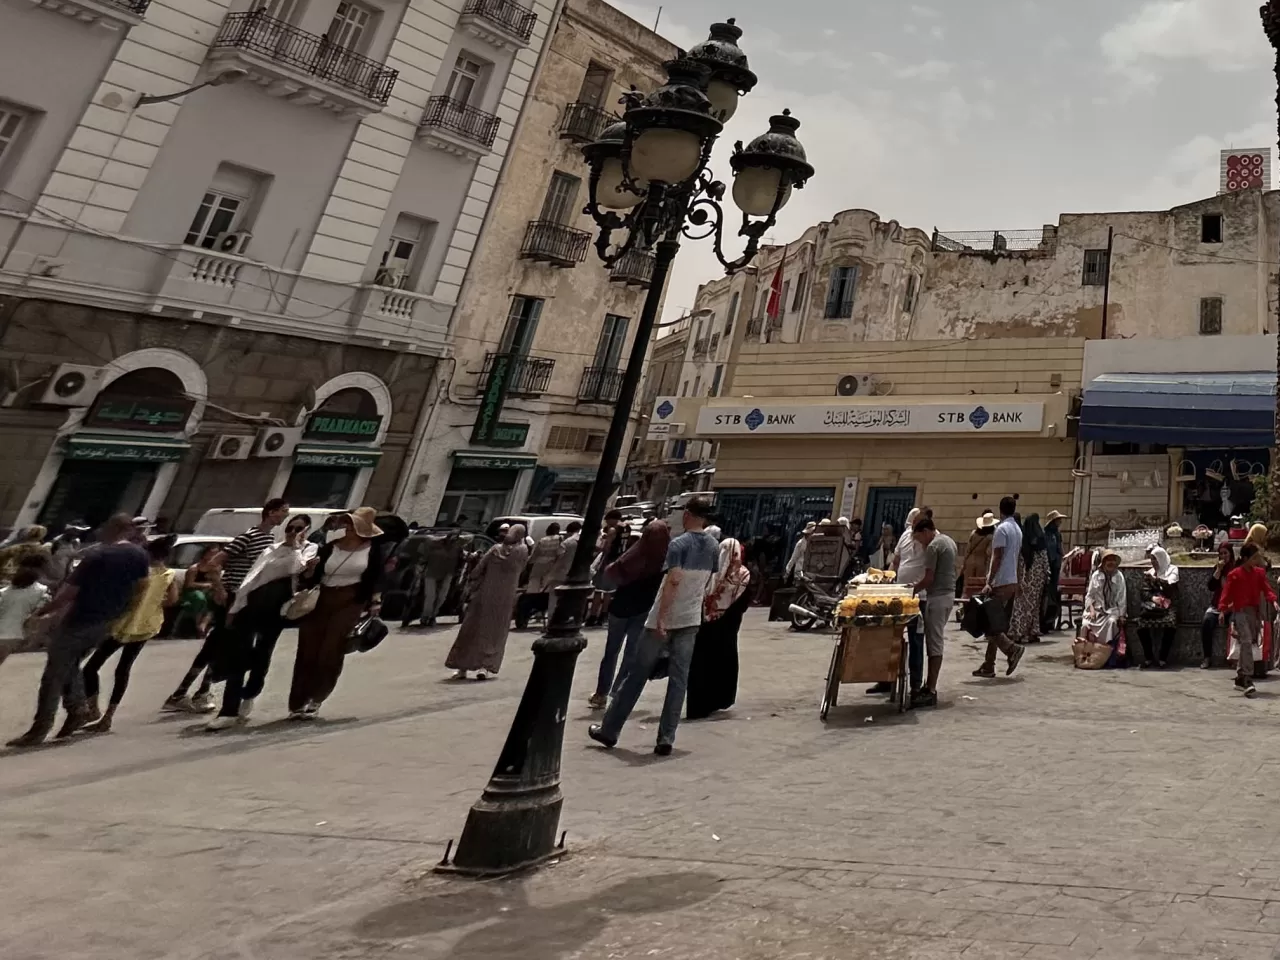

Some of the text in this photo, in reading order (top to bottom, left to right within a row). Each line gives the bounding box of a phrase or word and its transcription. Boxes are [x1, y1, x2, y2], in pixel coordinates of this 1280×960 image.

[715, 414, 796, 425] STB BANK
[938, 412, 1023, 423] STB BANK
[310, 416, 378, 435] PHARMACIE
